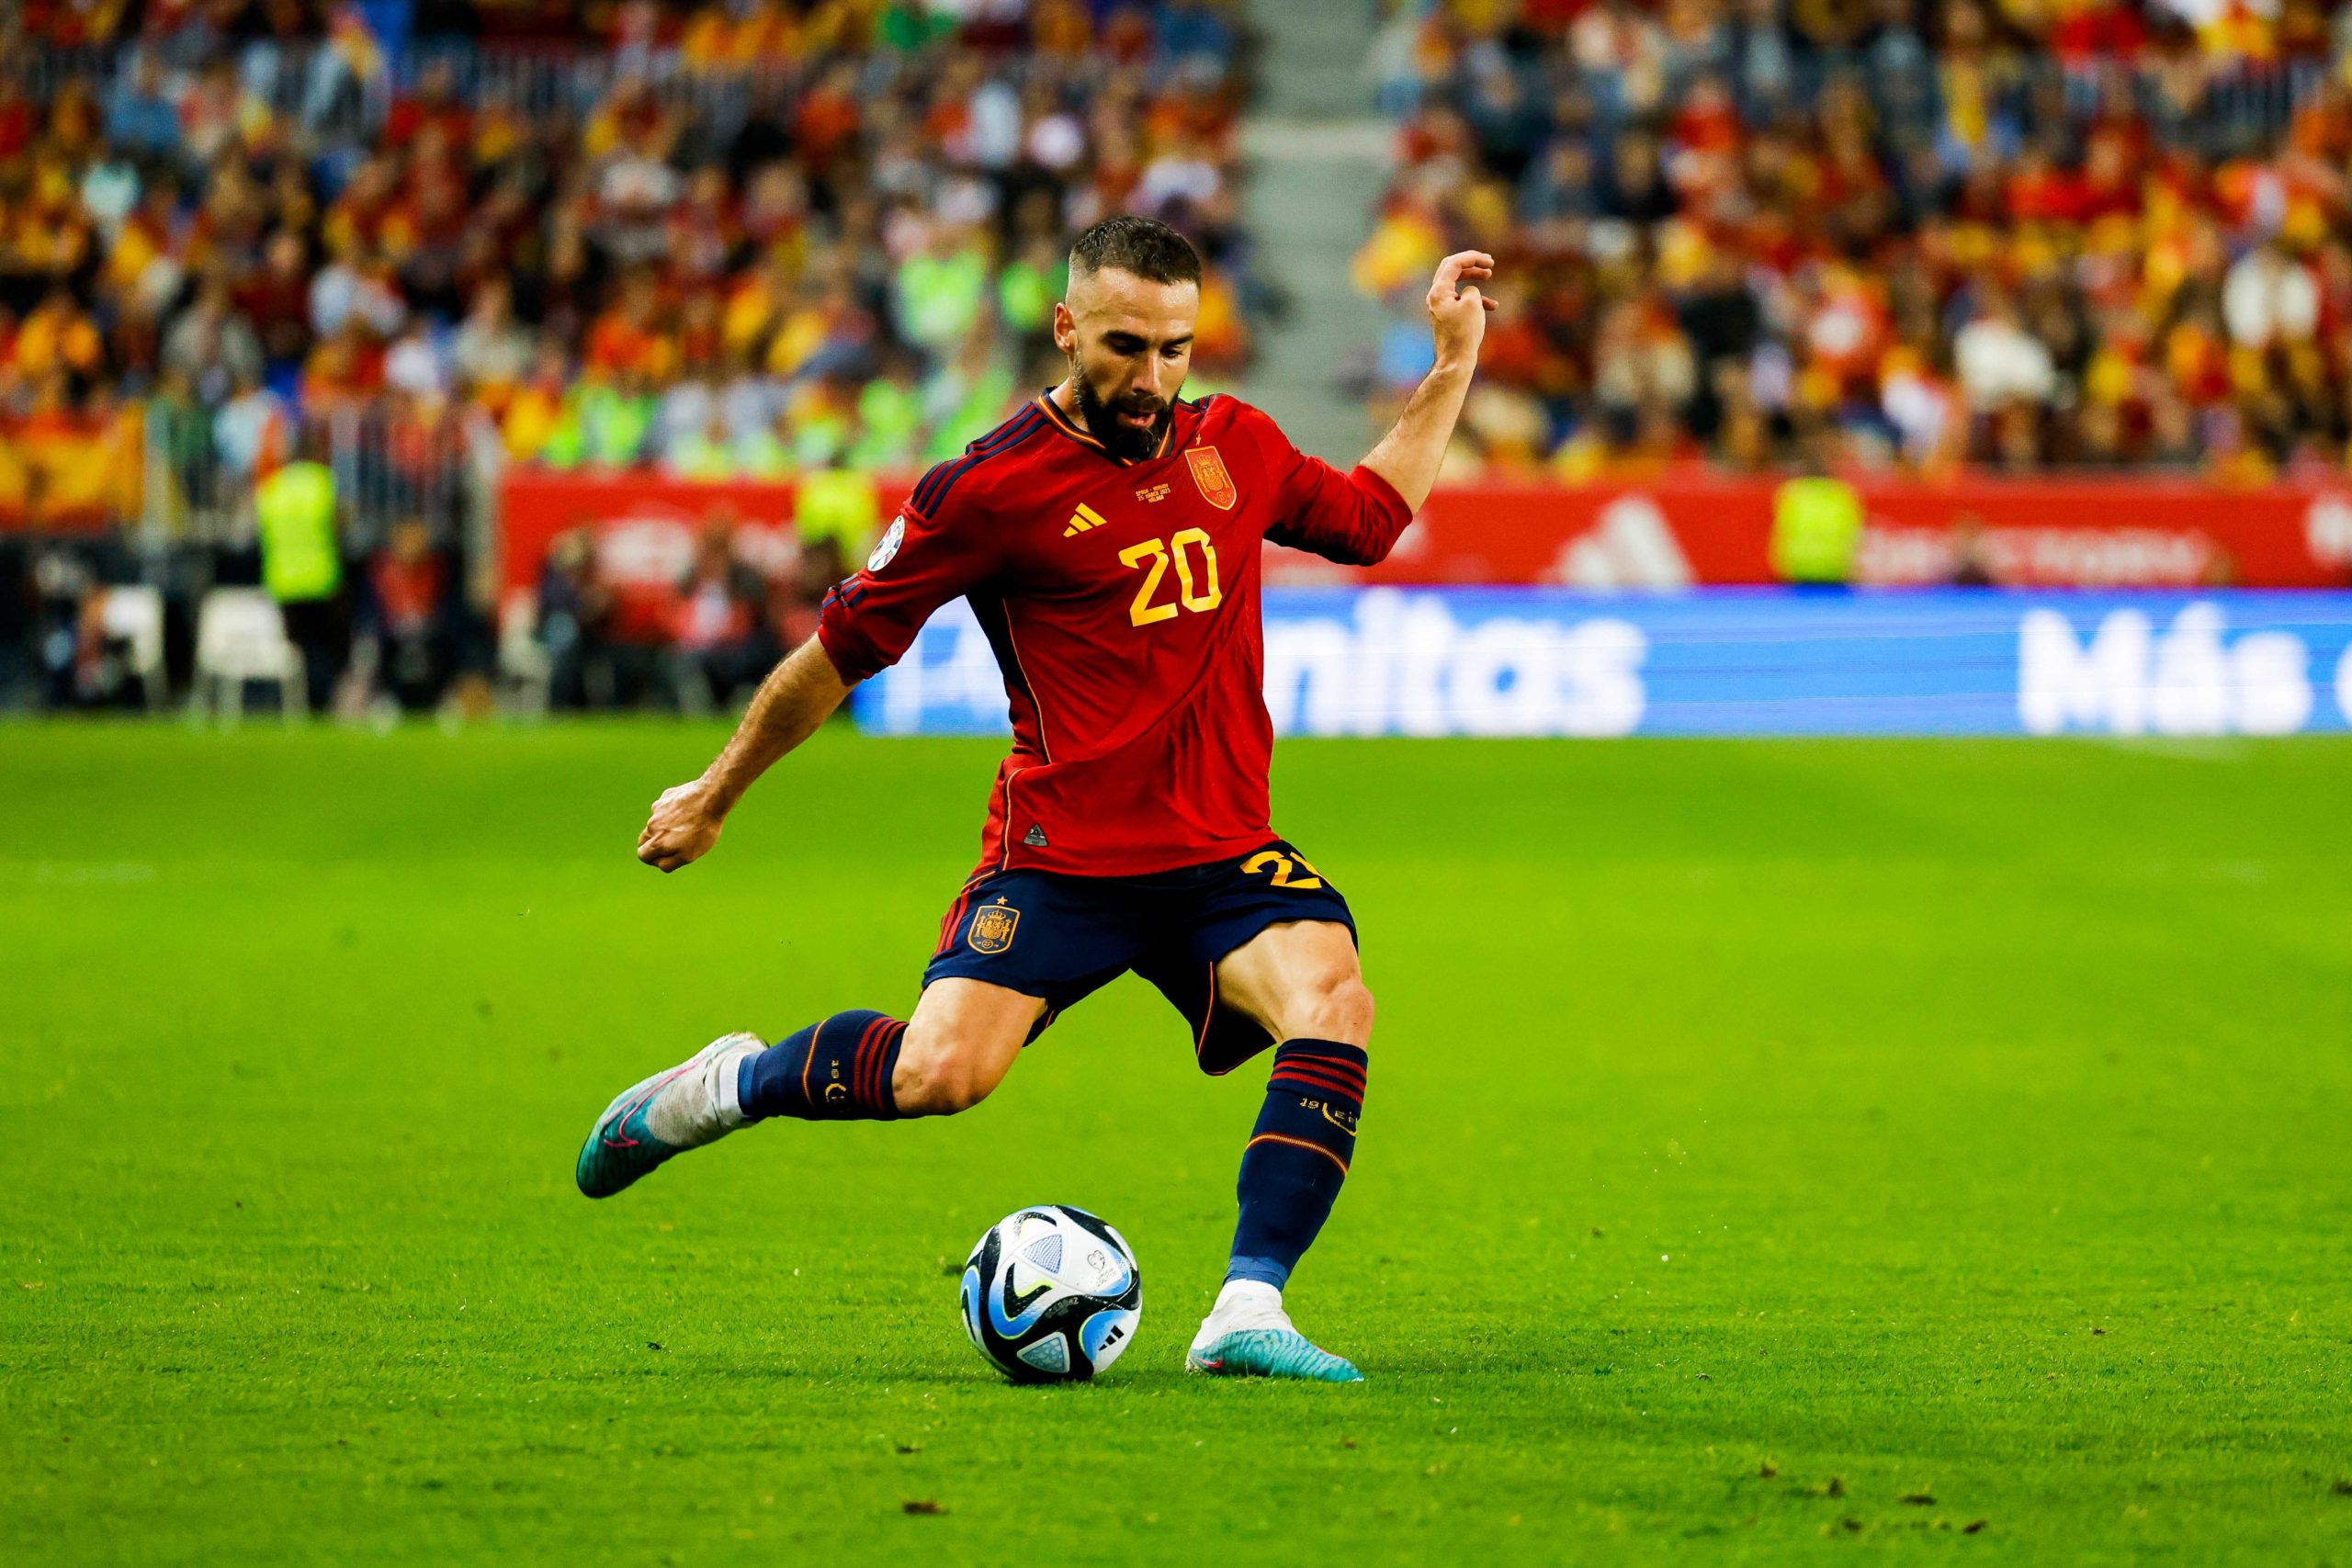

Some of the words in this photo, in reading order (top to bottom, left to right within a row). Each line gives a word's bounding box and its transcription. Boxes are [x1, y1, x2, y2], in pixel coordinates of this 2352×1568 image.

[1118, 526, 1223, 627] 20
[1261, 586, 1646, 738] nitas
[2018, 599, 2314, 738] Más
[1239, 851, 1330, 889] 2
